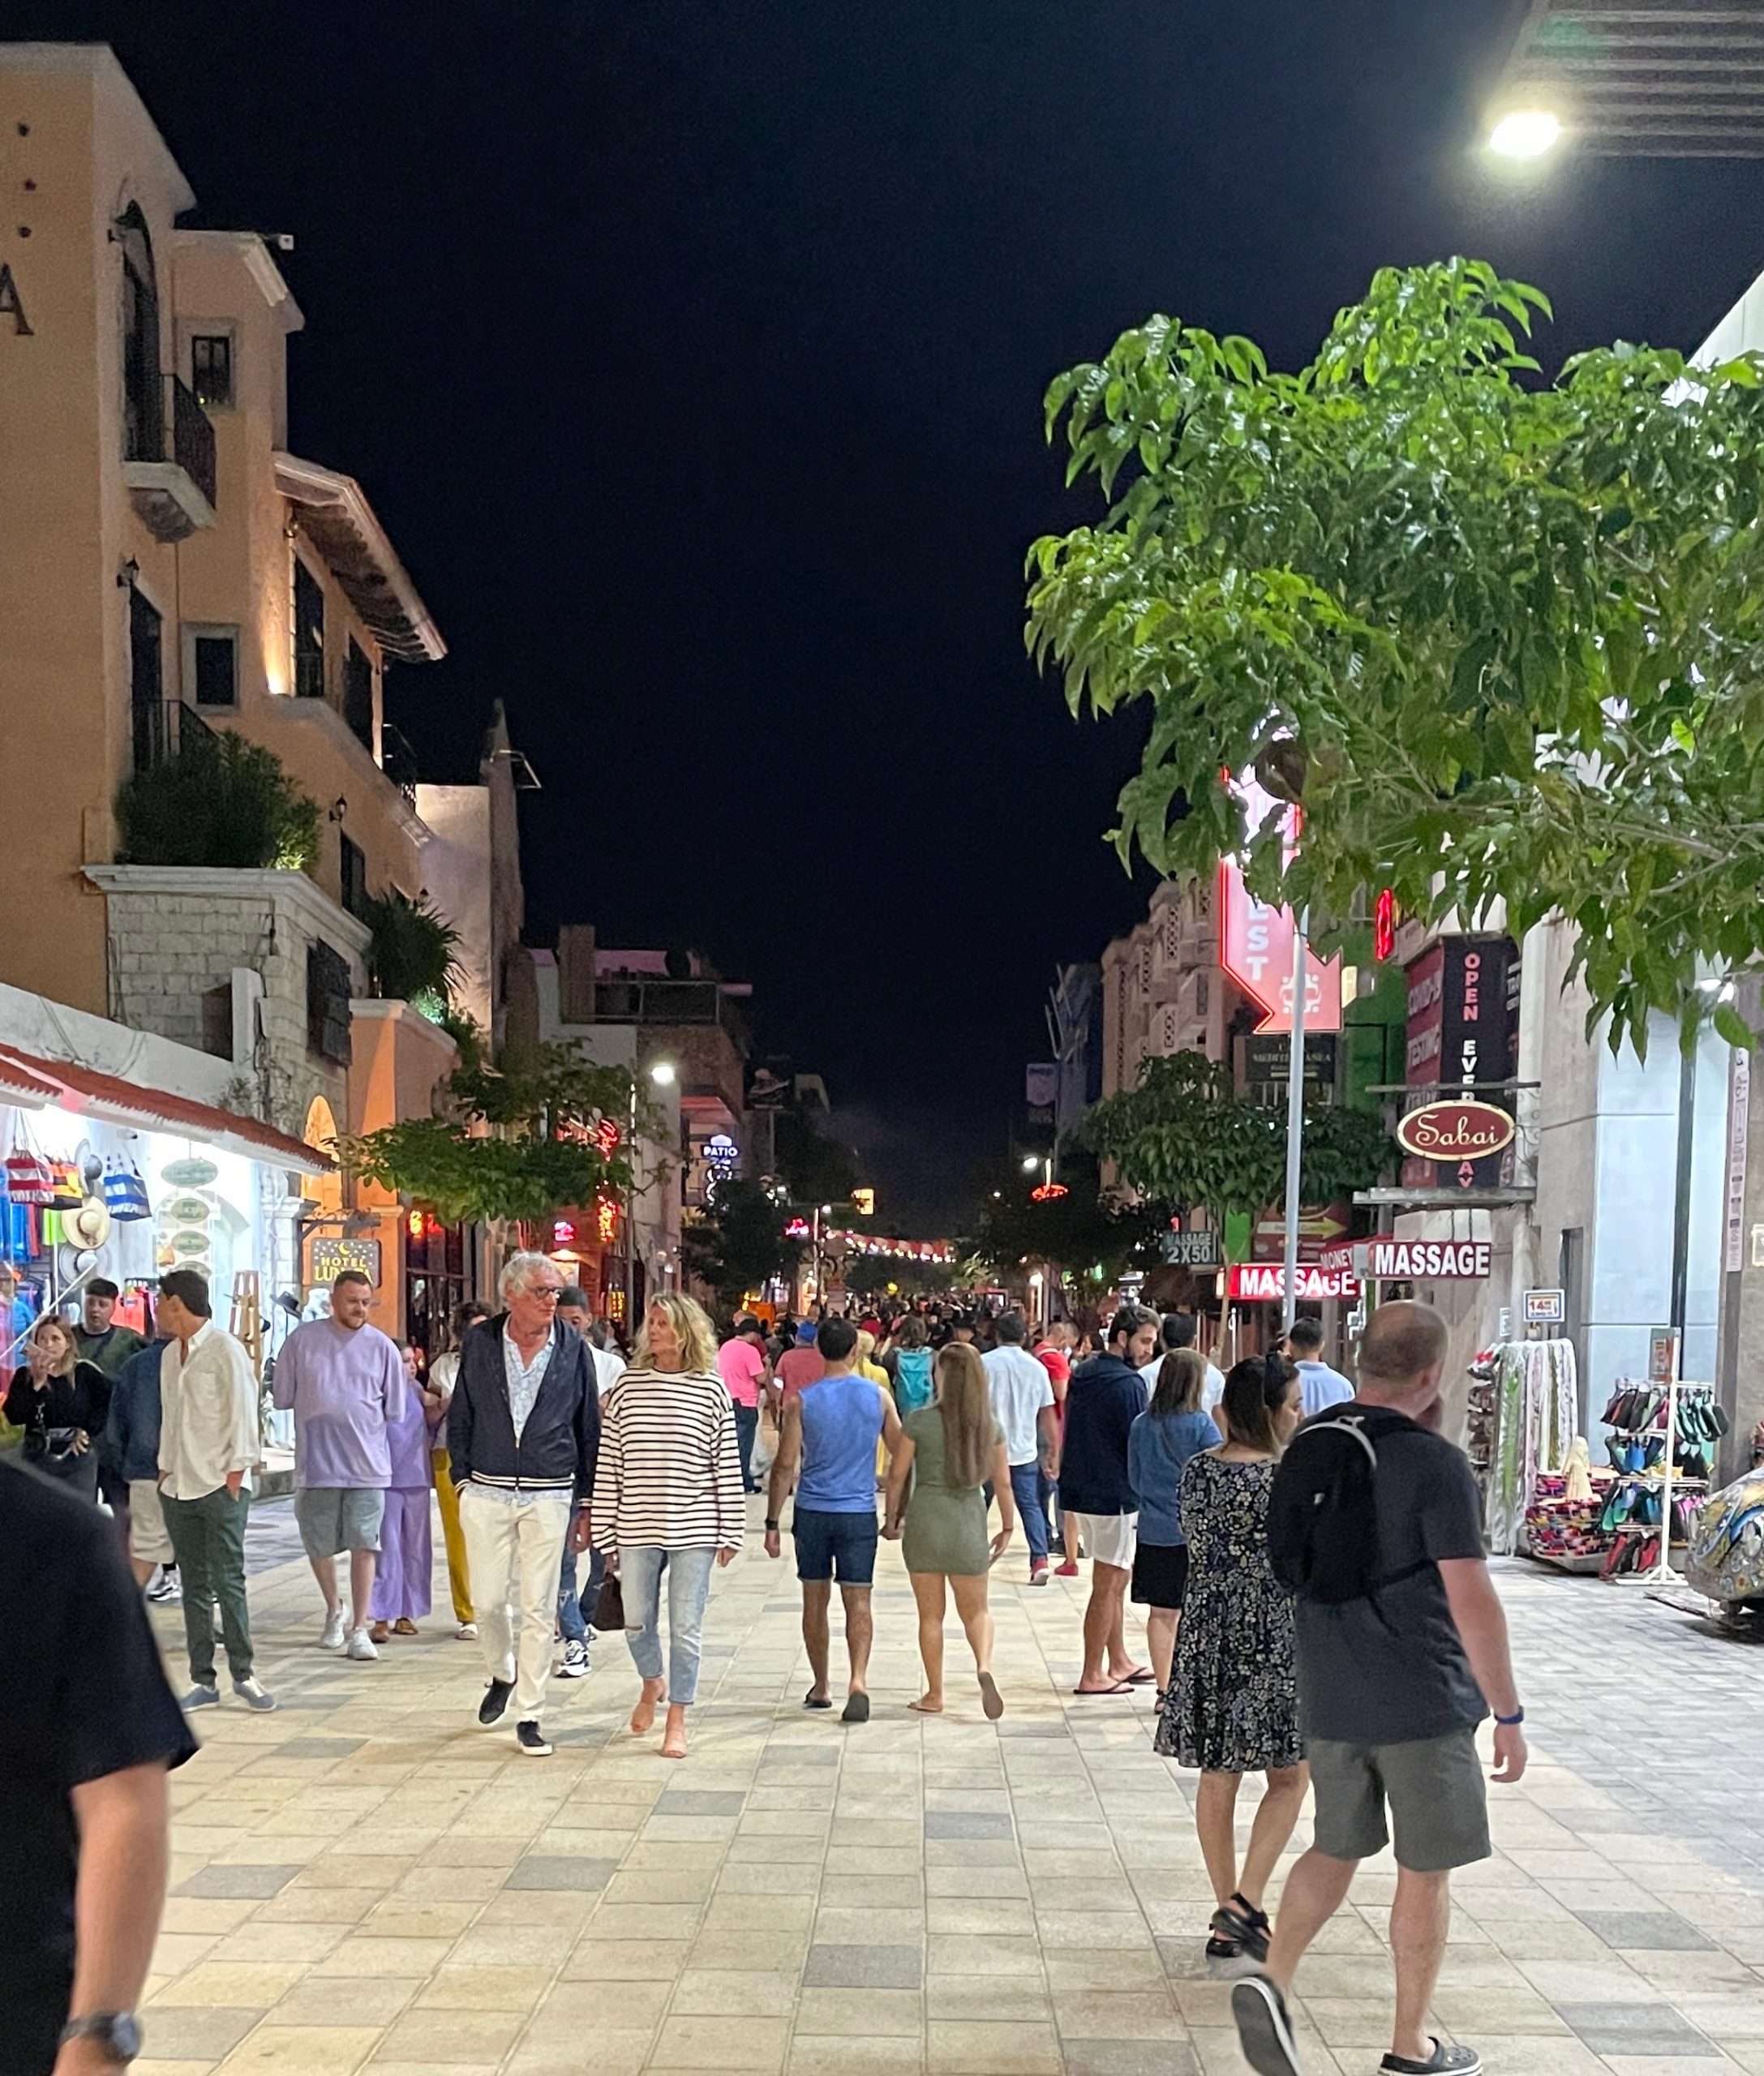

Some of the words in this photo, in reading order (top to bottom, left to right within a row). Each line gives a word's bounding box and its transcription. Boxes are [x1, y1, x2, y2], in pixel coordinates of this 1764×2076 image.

[1462, 952, 1481, 1022] OPEN
[1461, 1039, 1477, 1102] EVER
[1415, 1113, 1499, 1147] Sabai
[703, 1145, 738, 1157] PATIO
[1166, 1232, 1211, 1246] MASSAGE
[321, 1256, 367, 1267] HOTEL
[1320, 1247, 1353, 1271] MONEY
[1376, 1244, 1490, 1276] MASSAGE
[1240, 1268, 1356, 1297] MASSAGE
